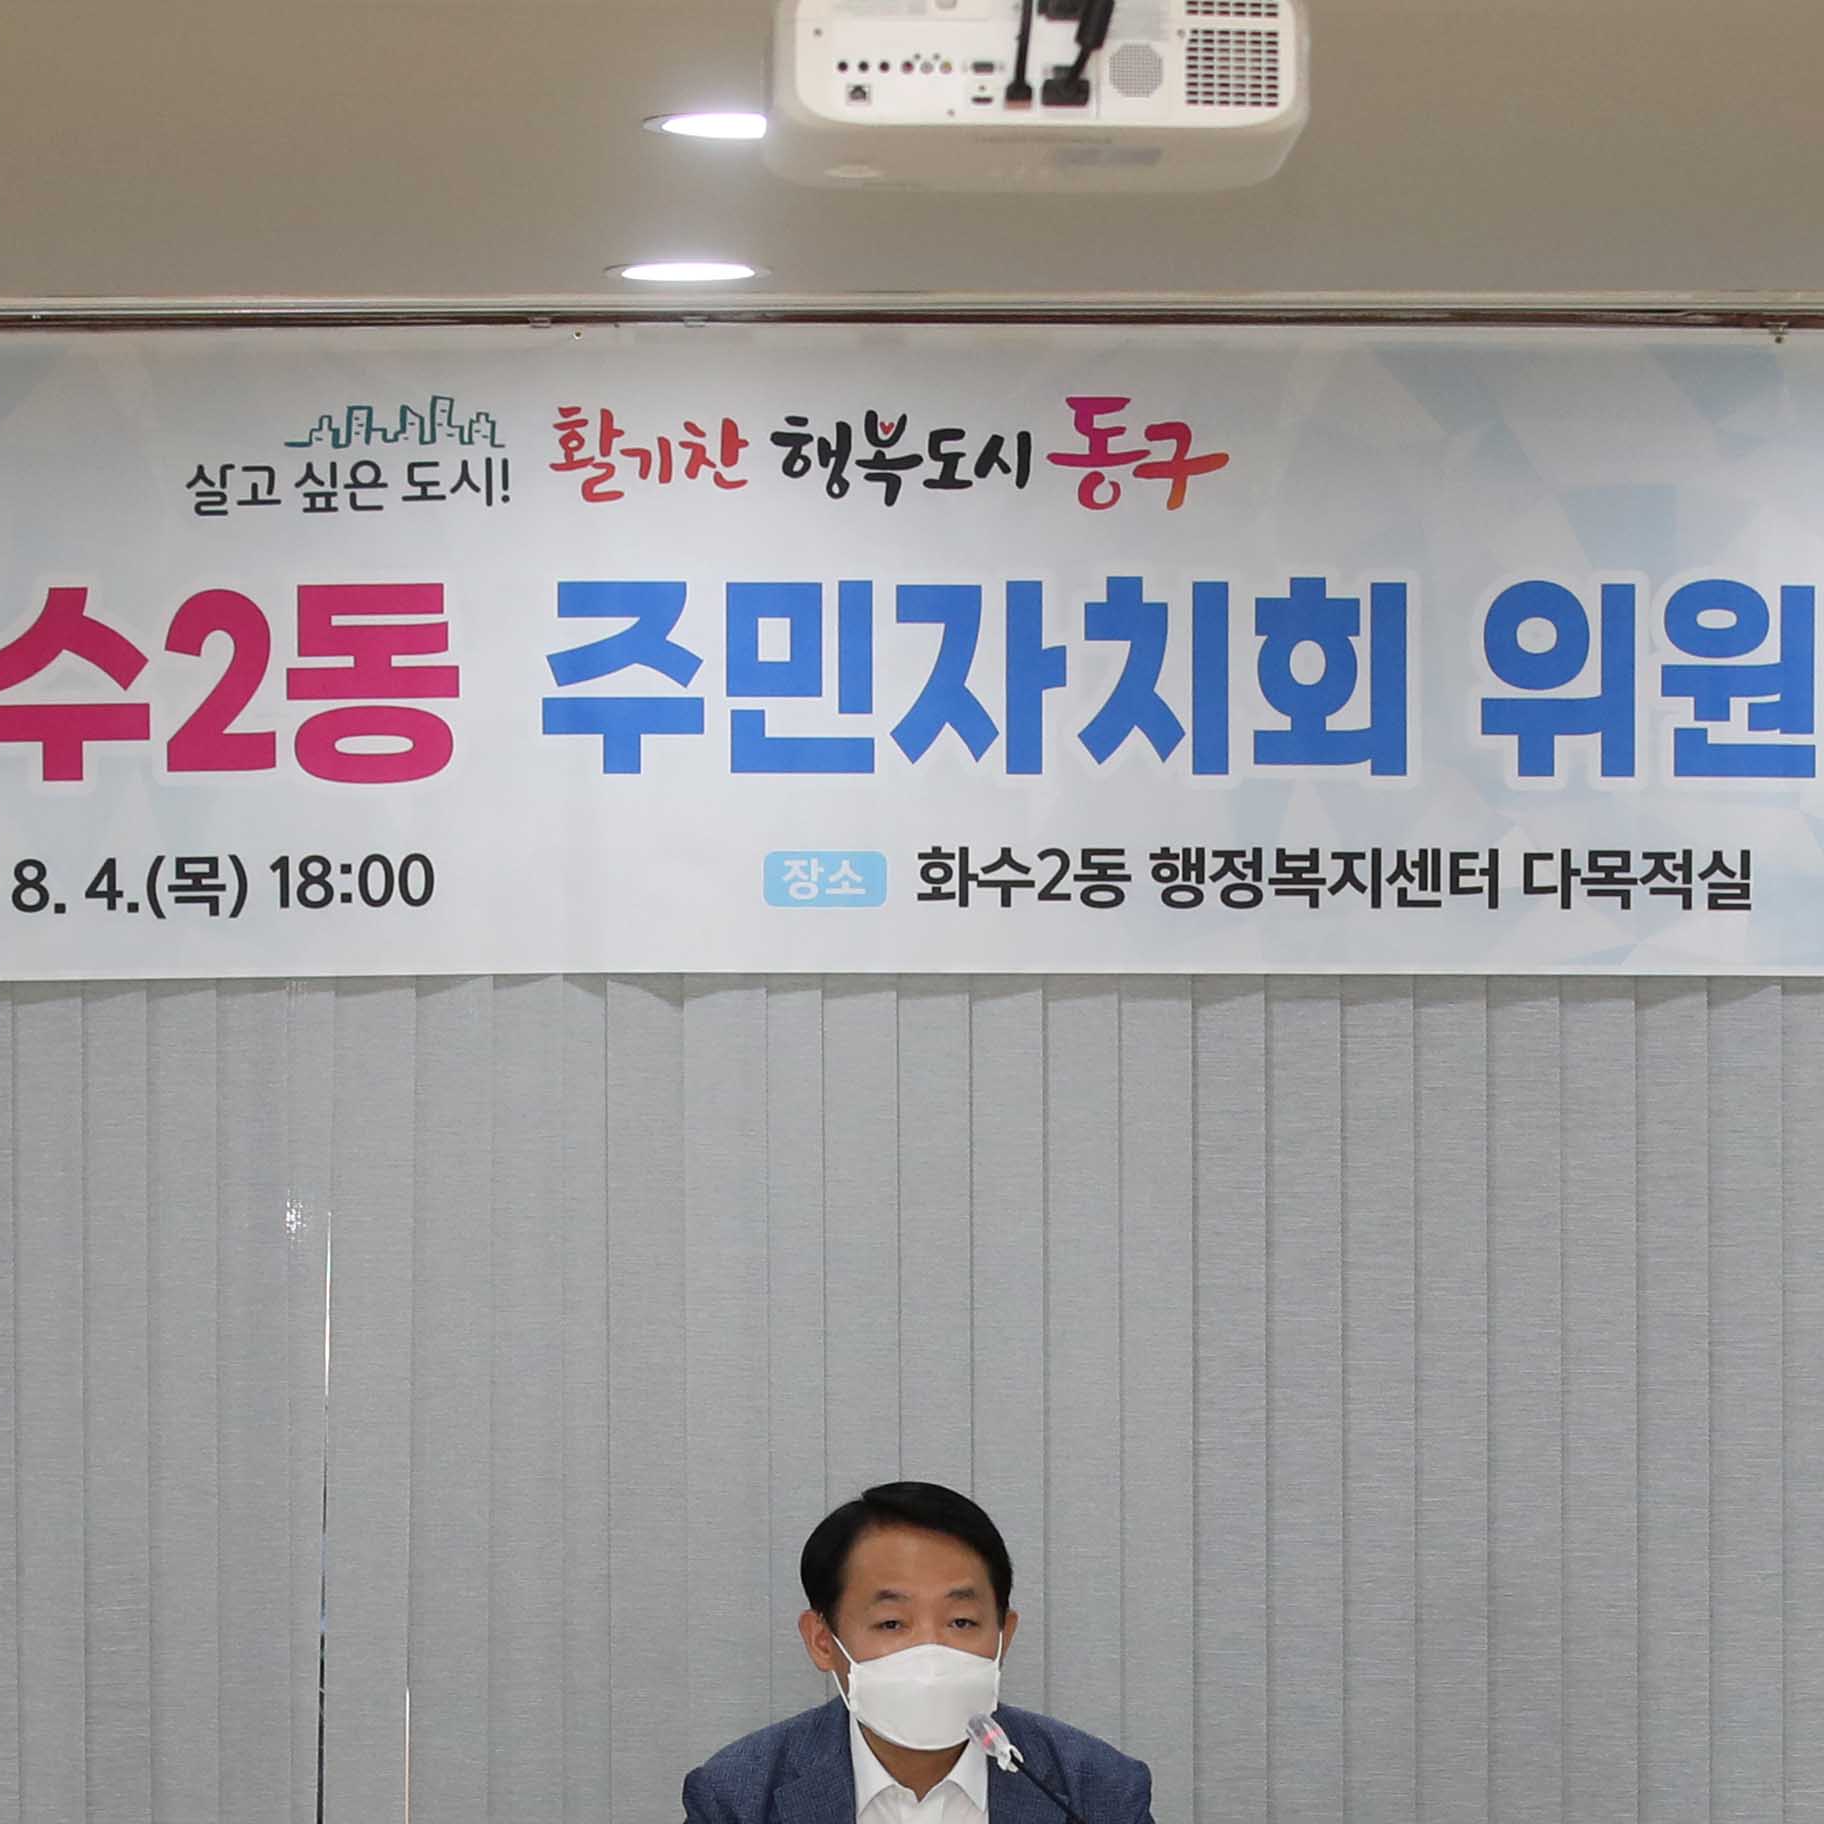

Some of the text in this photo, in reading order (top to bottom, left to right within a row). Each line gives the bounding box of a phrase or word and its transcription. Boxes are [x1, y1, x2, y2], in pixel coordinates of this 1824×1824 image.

[185, 455, 511, 518] 살고 싶은 도시!
[548, 395, 1232, 512] 활기찬 행복도시 동구
[541, 574, 1409, 778] 주민자치회
[1479, 577, 1817, 780] 위원
[10, 857, 68, 915] 8.
[268, 851, 436, 910] 18:00
[781, 857, 866, 901] 장소
[916, 844, 1753, 912] 화수2동 행정복지센터 다목적실
